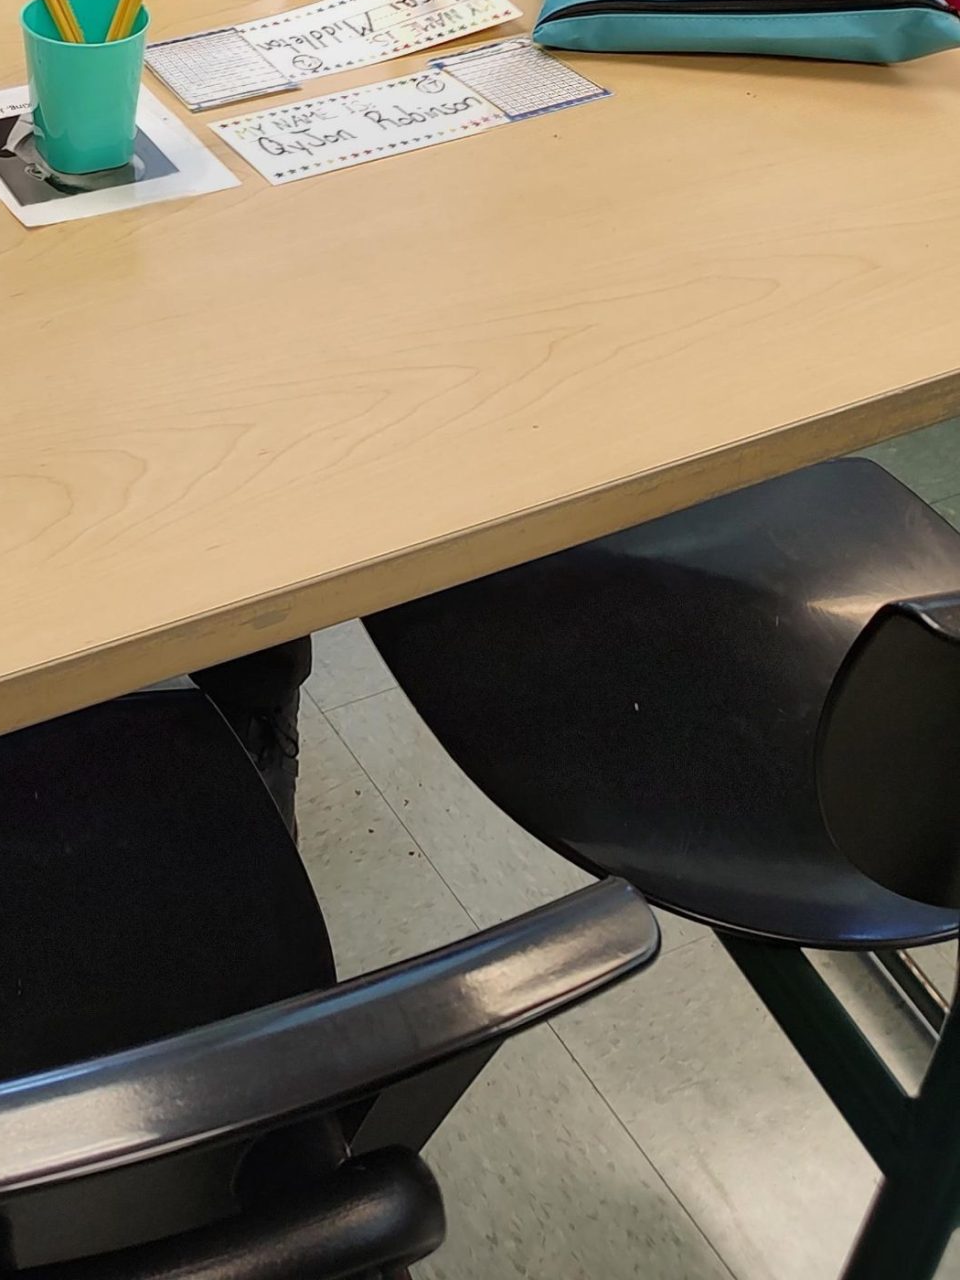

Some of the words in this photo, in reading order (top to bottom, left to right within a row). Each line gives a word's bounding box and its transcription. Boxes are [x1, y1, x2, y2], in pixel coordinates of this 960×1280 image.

[255, 11, 375, 54] Middleton
[272, 109, 338, 130] NAME
[364, 97, 483, 130] Robinson
